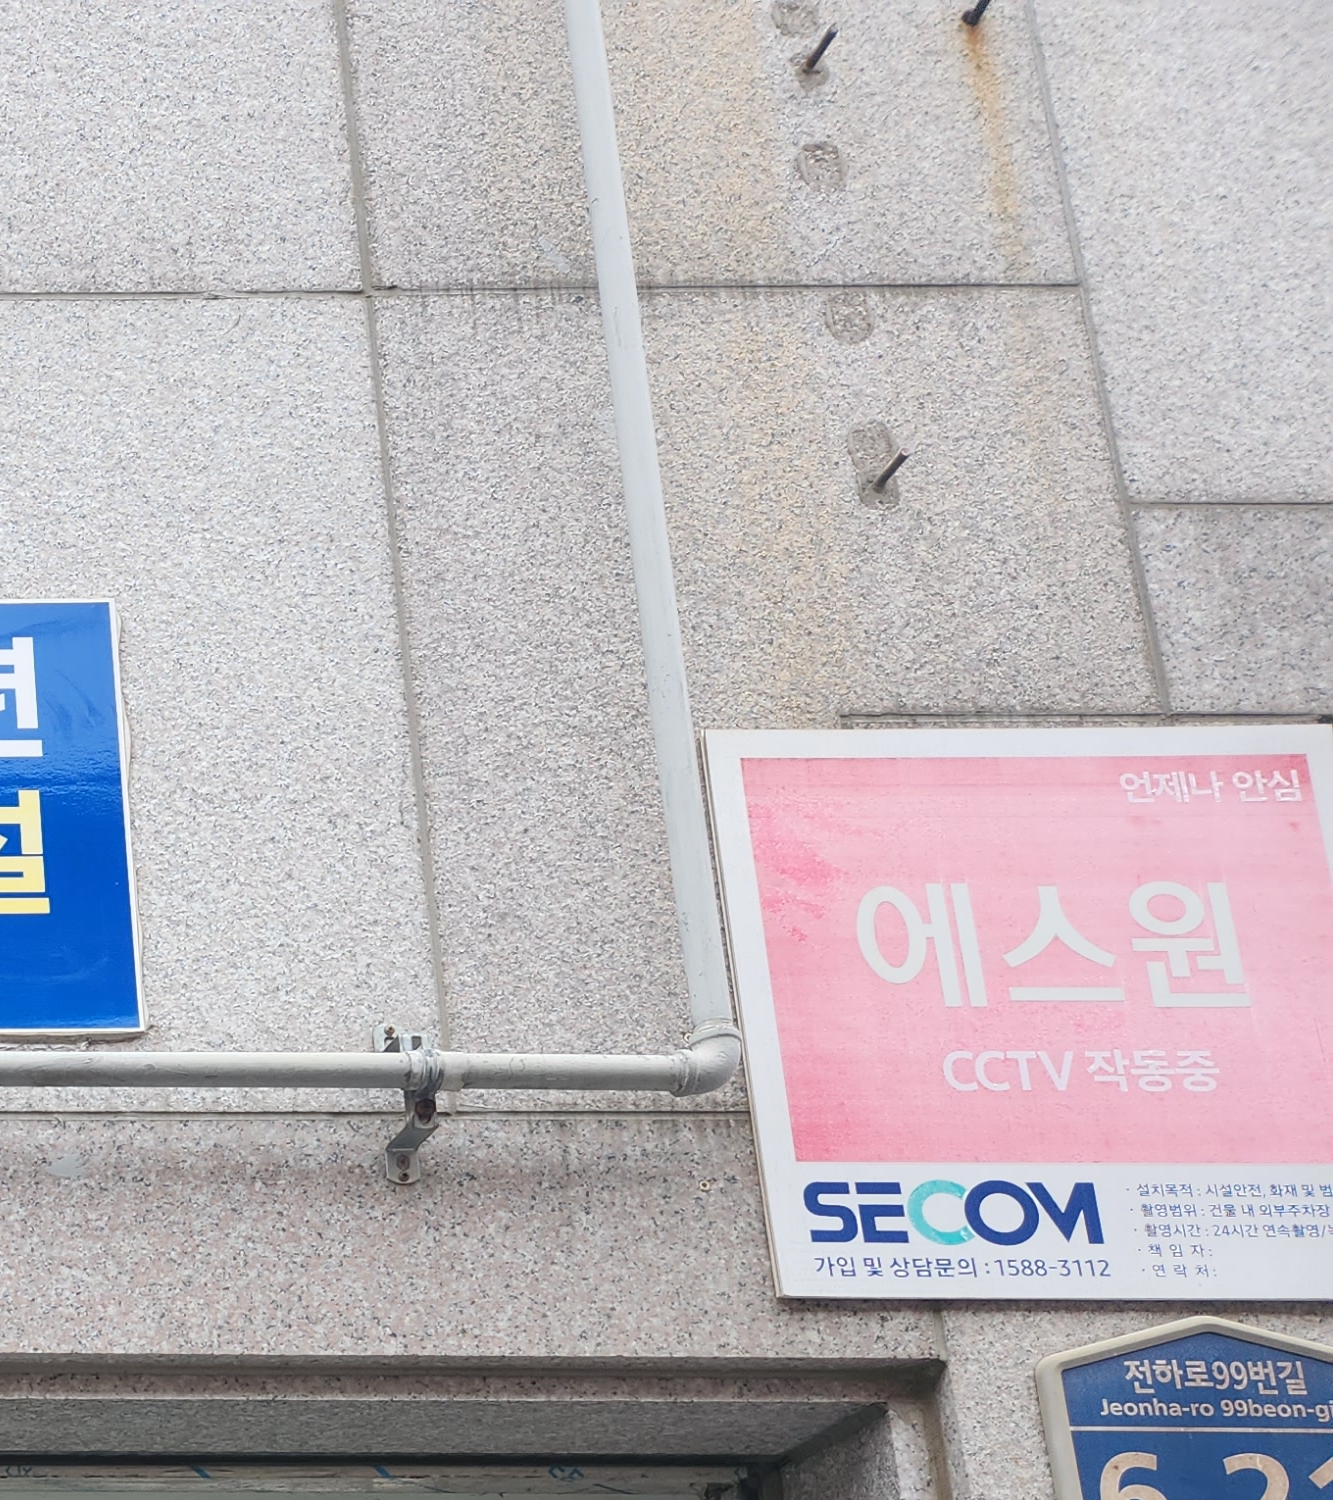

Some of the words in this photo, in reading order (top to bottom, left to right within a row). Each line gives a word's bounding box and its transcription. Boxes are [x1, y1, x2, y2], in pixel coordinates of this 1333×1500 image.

[1118, 770, 1223, 803] 언제나
[1232, 769, 1303, 803] 안심
[855, 881, 1251, 1008] 에스원
[942, 1050, 1074, 1092] CCTV
[1085, 1049, 1220, 1092] 작동중
[1269, 1184, 1298, 1198] 화재
[803, 1179, 1105, 1246] SECOM
[1212, 1223, 1259, 1238] 24시간
[814, 1257, 856, 1277] 가입
[863, 1257, 884, 1277] 및
[1123, 1358, 1308, 1396] 전하로99번길
[1100, 1398, 1215, 1418] Jeonha-ro
